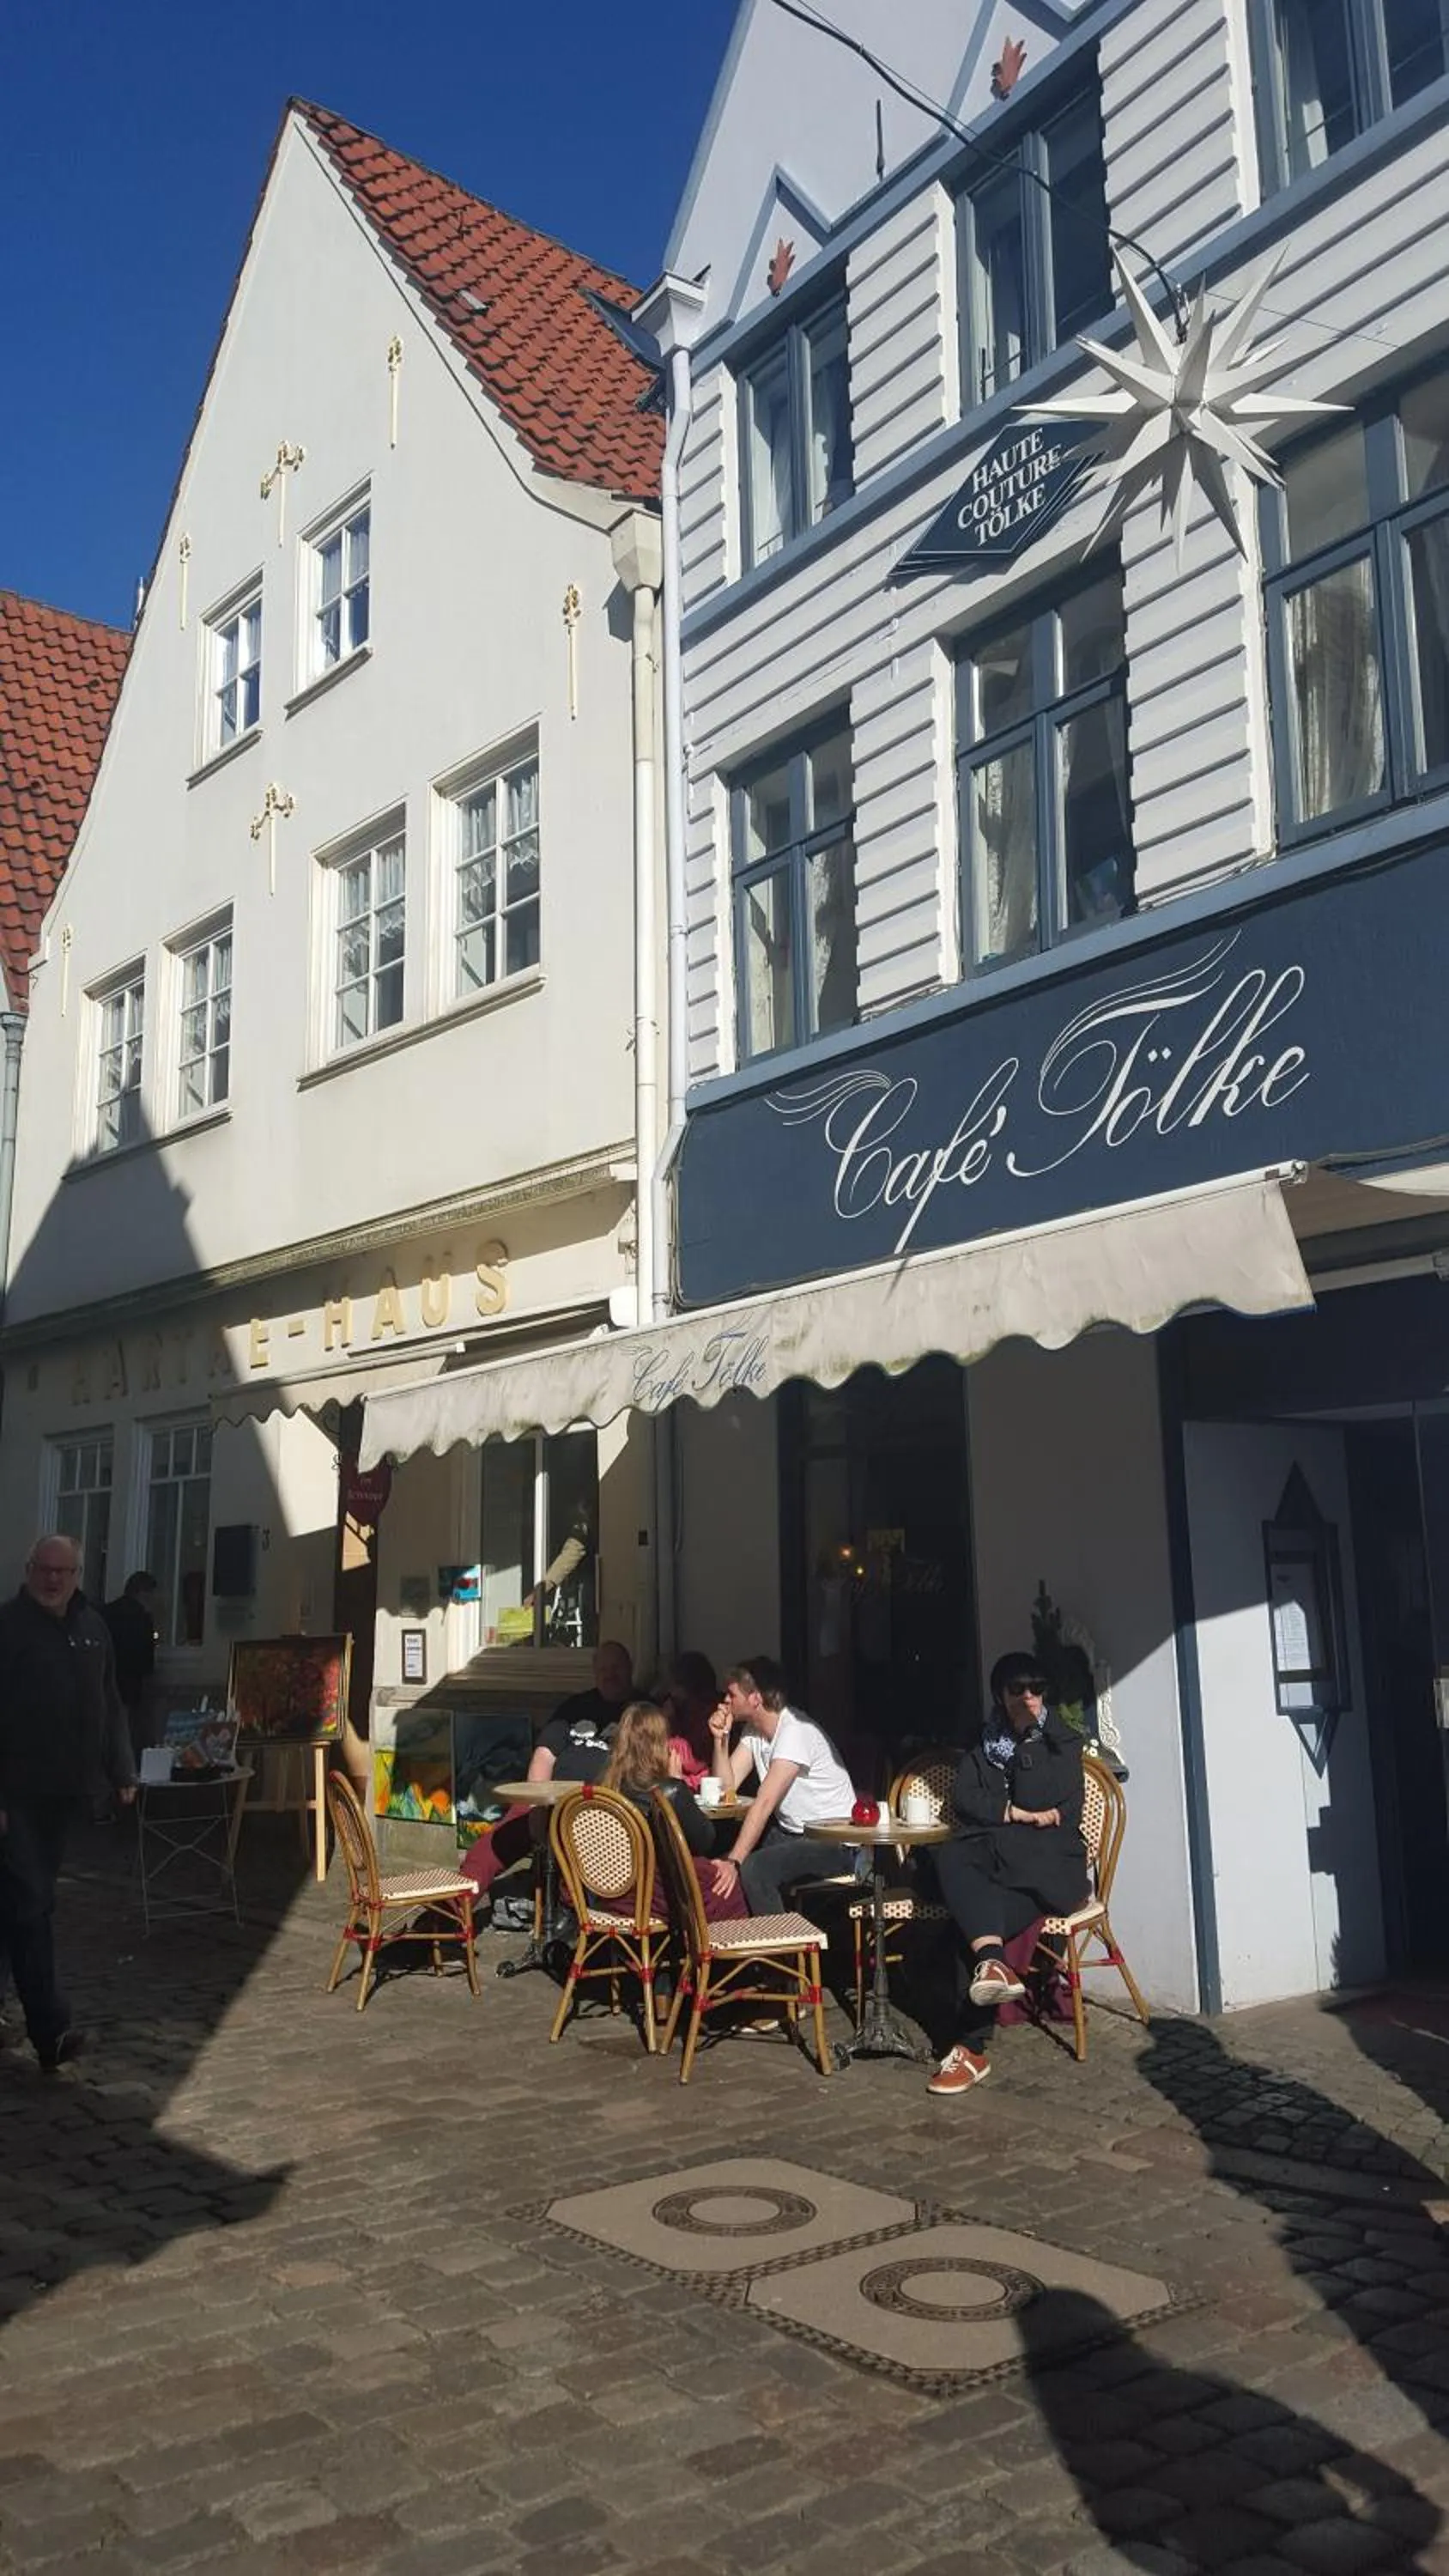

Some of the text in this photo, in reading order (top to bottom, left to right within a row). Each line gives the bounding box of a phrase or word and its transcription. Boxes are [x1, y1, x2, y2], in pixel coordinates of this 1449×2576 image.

[957, 443, 1063, 530] COUTURE
[972, 428, 1045, 495] HAUTE
[974, 483, 1046, 547] TÖLKE
[764, 928, 1311, 1255] Café Tölke
